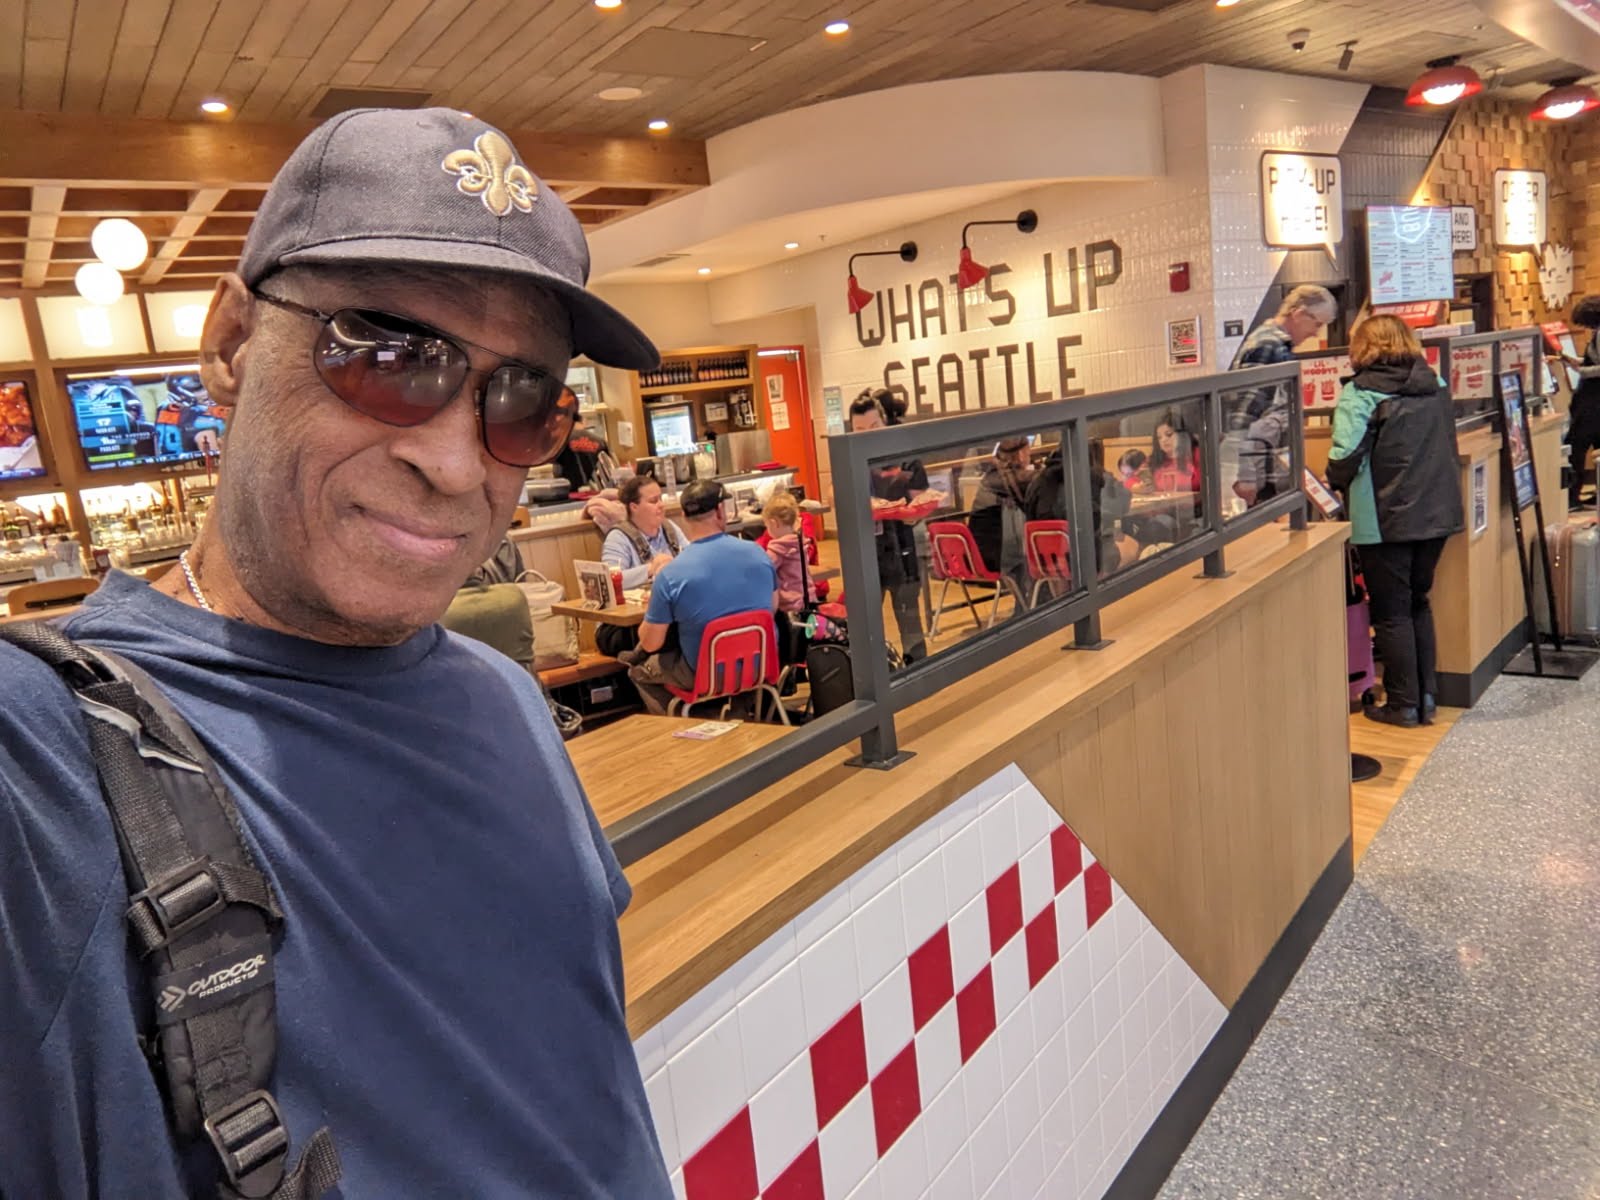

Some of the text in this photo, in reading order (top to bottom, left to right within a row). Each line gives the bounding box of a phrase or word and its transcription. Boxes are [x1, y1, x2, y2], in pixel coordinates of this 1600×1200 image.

[1454, 212, 1469, 226] AND
[1043, 239, 1122, 318] UP
[883, 334, 1086, 416] SEATTLE
[187, 954, 267, 996] OUTDOOR
[198, 968, 259, 997] PRODUCTS
